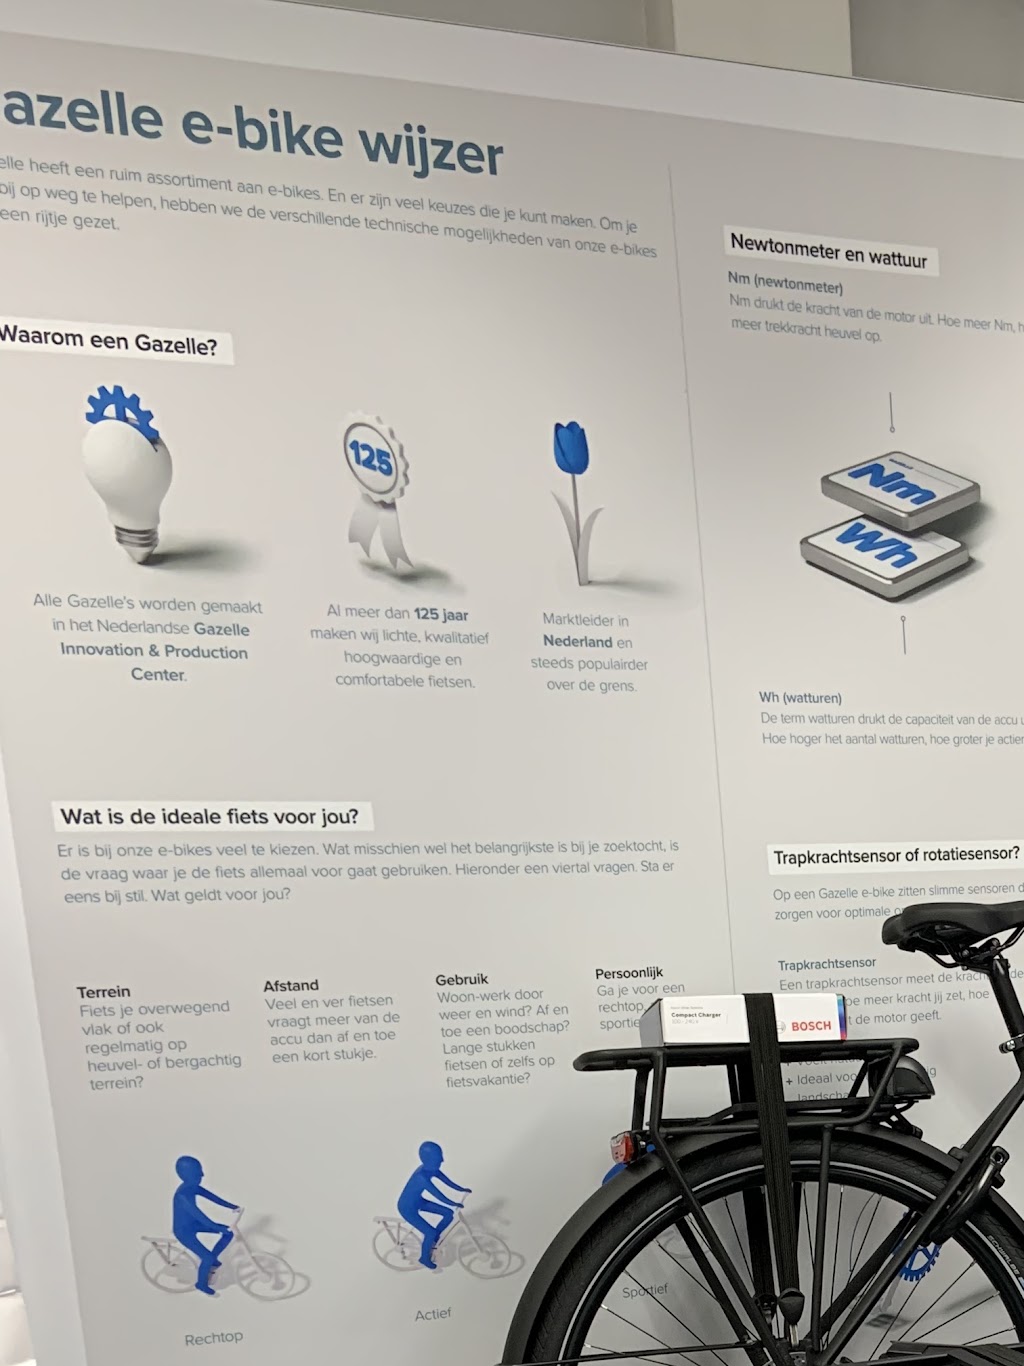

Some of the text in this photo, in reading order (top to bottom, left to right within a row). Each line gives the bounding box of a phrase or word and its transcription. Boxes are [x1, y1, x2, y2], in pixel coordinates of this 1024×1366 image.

[3, 89, 503, 179] azelle e-bike wijzer
[731, 232, 927, 269] Newtonmeter en wattuur
[728, 270, 843, 294] Nm (newtonmeter)
[0, 324, 217, 356] Waarom een Gazelle?
[349, 439, 393, 476] 125
[848, 463, 937, 505] Nm
[836, 522, 918, 569] Wh
[33, 593, 263, 615] Alle Gazelle's worden gemaakt
[327, 604, 468, 624] Al meer dan 125 jaar
[60, 641, 248, 659] Innovation & Production
[543, 634, 632, 648] Nederland en
[131, 667, 186, 681] Center.
[758, 690, 841, 706] Wh (watturen)
[60, 808, 358, 828] Wat is de ideale fiets voor jou?
[773, 845, 1020, 867] Trapkrachtsensor of rotatiesensor?
[64, 887, 290, 906] eens bij stil. Wat geldt voor jou?
[595, 966, 663, 980] Persoonlijk
[777, 958, 876, 973] Trapkrachtsensor
[263, 979, 319, 992] Afstand
[435, 973, 488, 986] Gebruik
[76, 985, 130, 998] Terrein
[79, 1000, 230, 1019] Fiets je overwegend
[791, 1021, 832, 1032] BOSCH
[622, 1282, 669, 1300] Sportief
[415, 1306, 451, 1321] Actief
[184, 1331, 243, 1346] Rechtop
